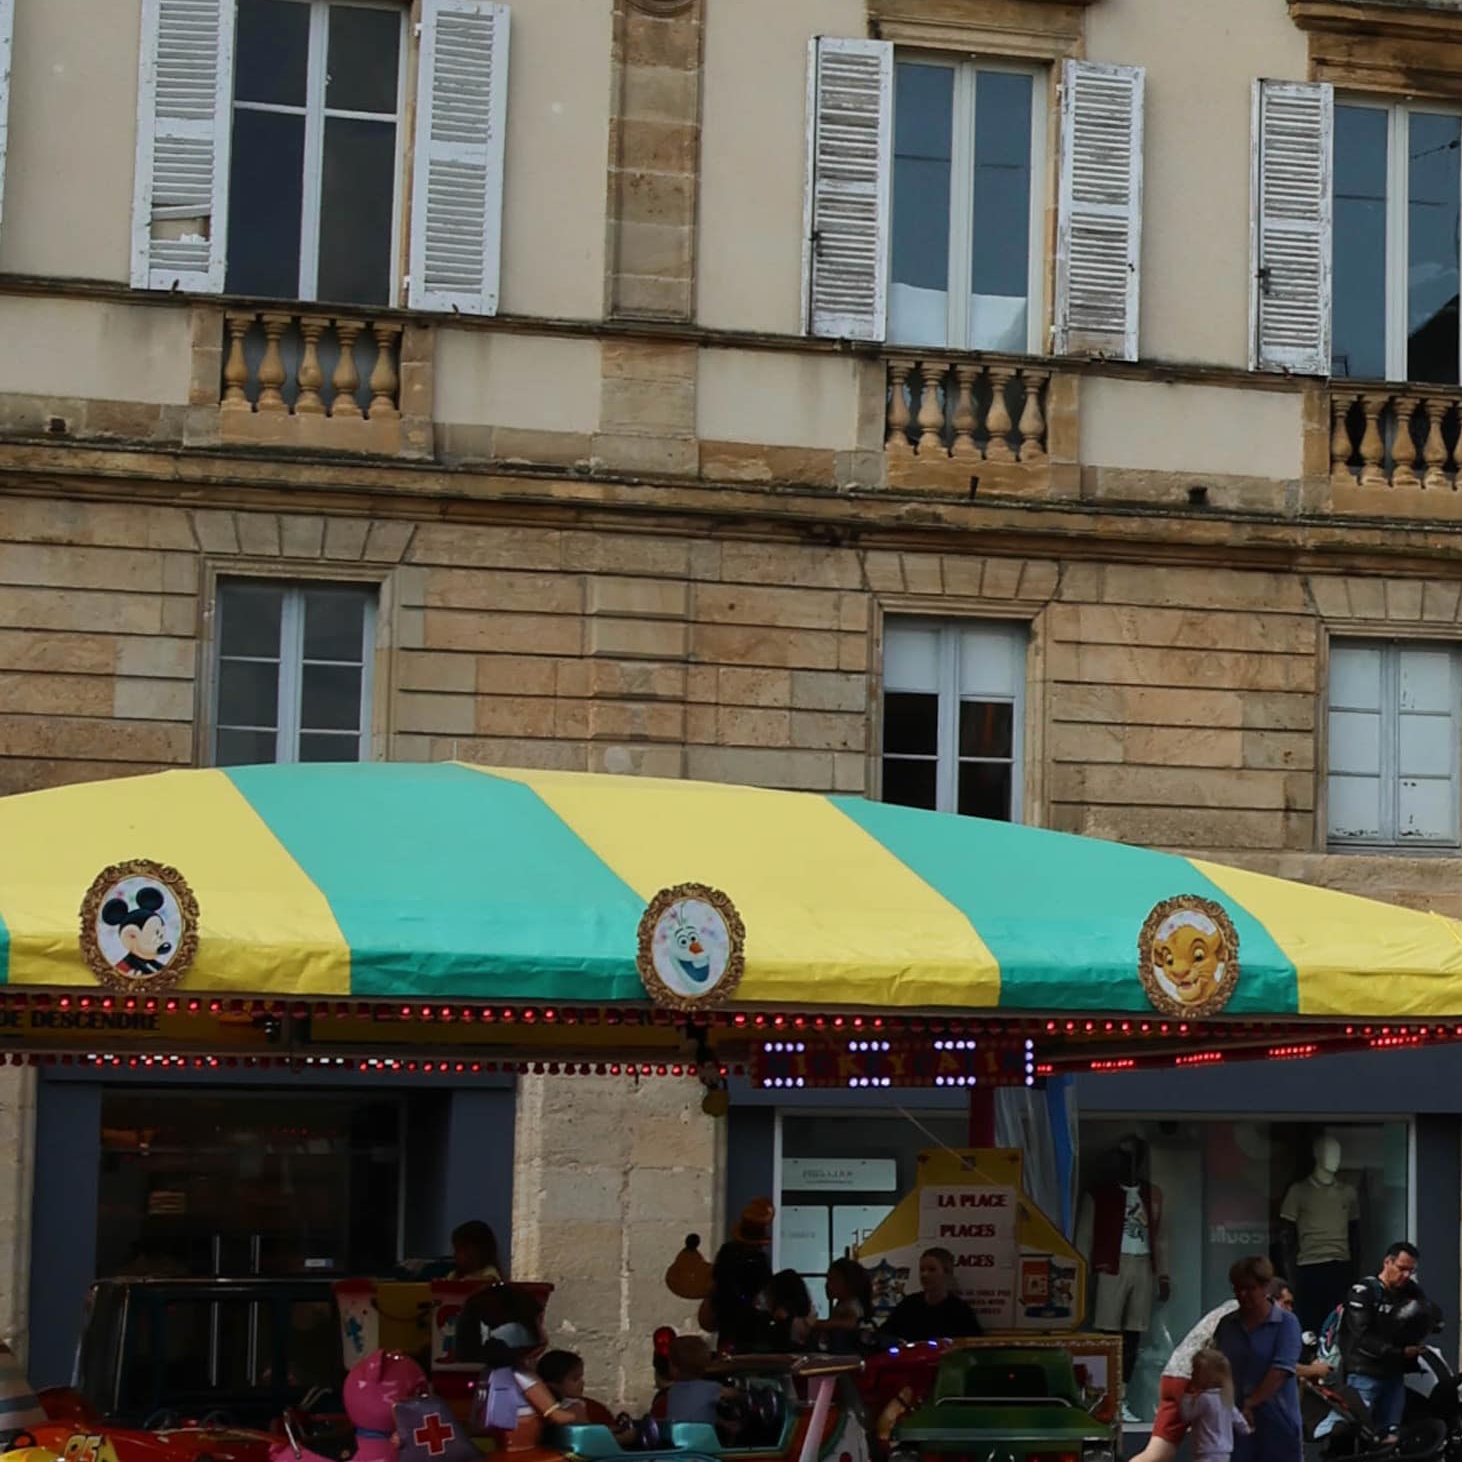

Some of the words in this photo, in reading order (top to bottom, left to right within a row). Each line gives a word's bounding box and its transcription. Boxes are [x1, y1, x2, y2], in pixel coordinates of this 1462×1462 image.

[31, 1011, 161, 1030] DESCENDRE
[937, 1194, 956, 1208] LA
[959, 1194, 1009, 1208] PLACE
[940, 1223, 996, 1238] PLACES
